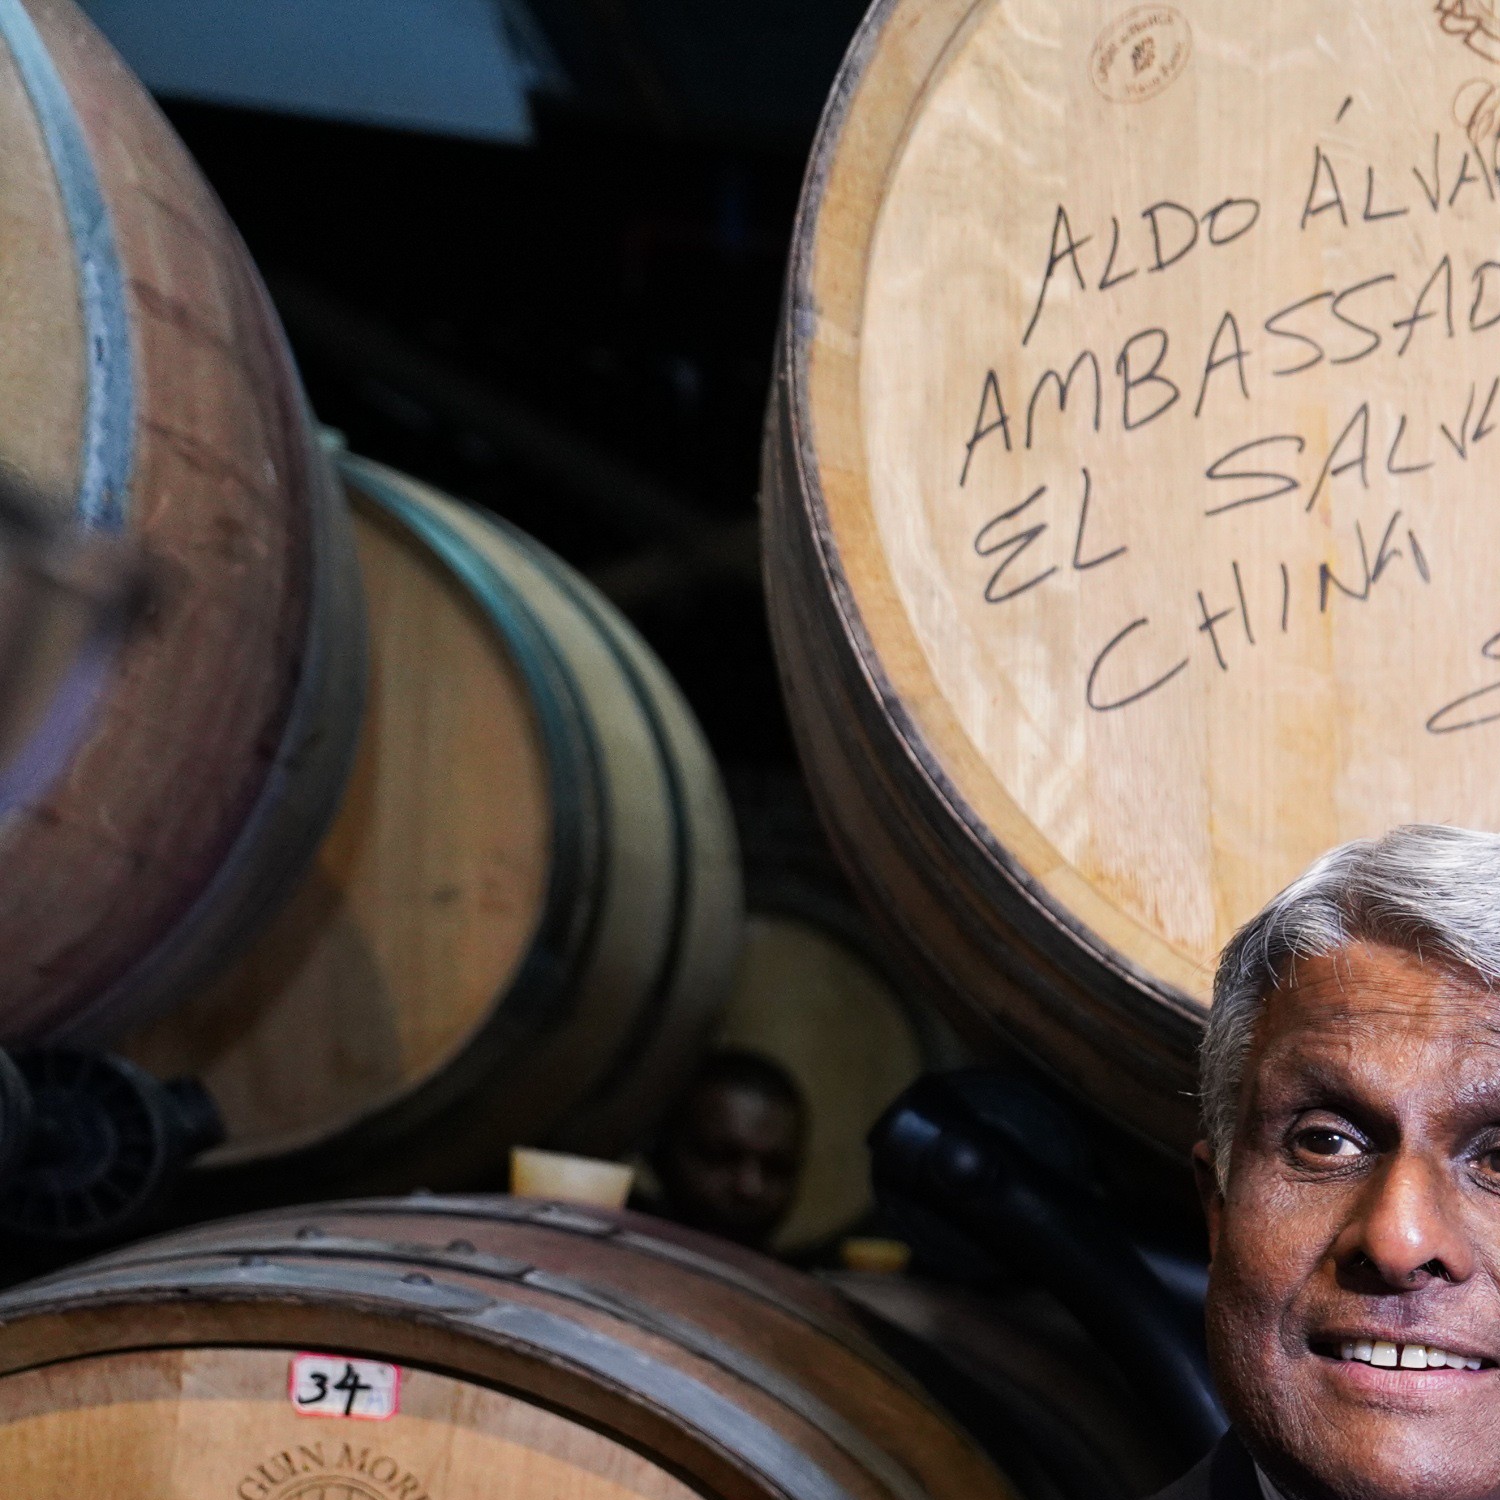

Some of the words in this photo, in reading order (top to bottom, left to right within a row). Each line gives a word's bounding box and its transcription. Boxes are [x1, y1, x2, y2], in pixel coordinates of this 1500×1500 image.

[1022, 198, 1260, 345] ALDO
[974, 467, 1129, 604] EL
[1086, 509, 1432, 711] CHINA
[298, 1363, 372, 1417] 34
